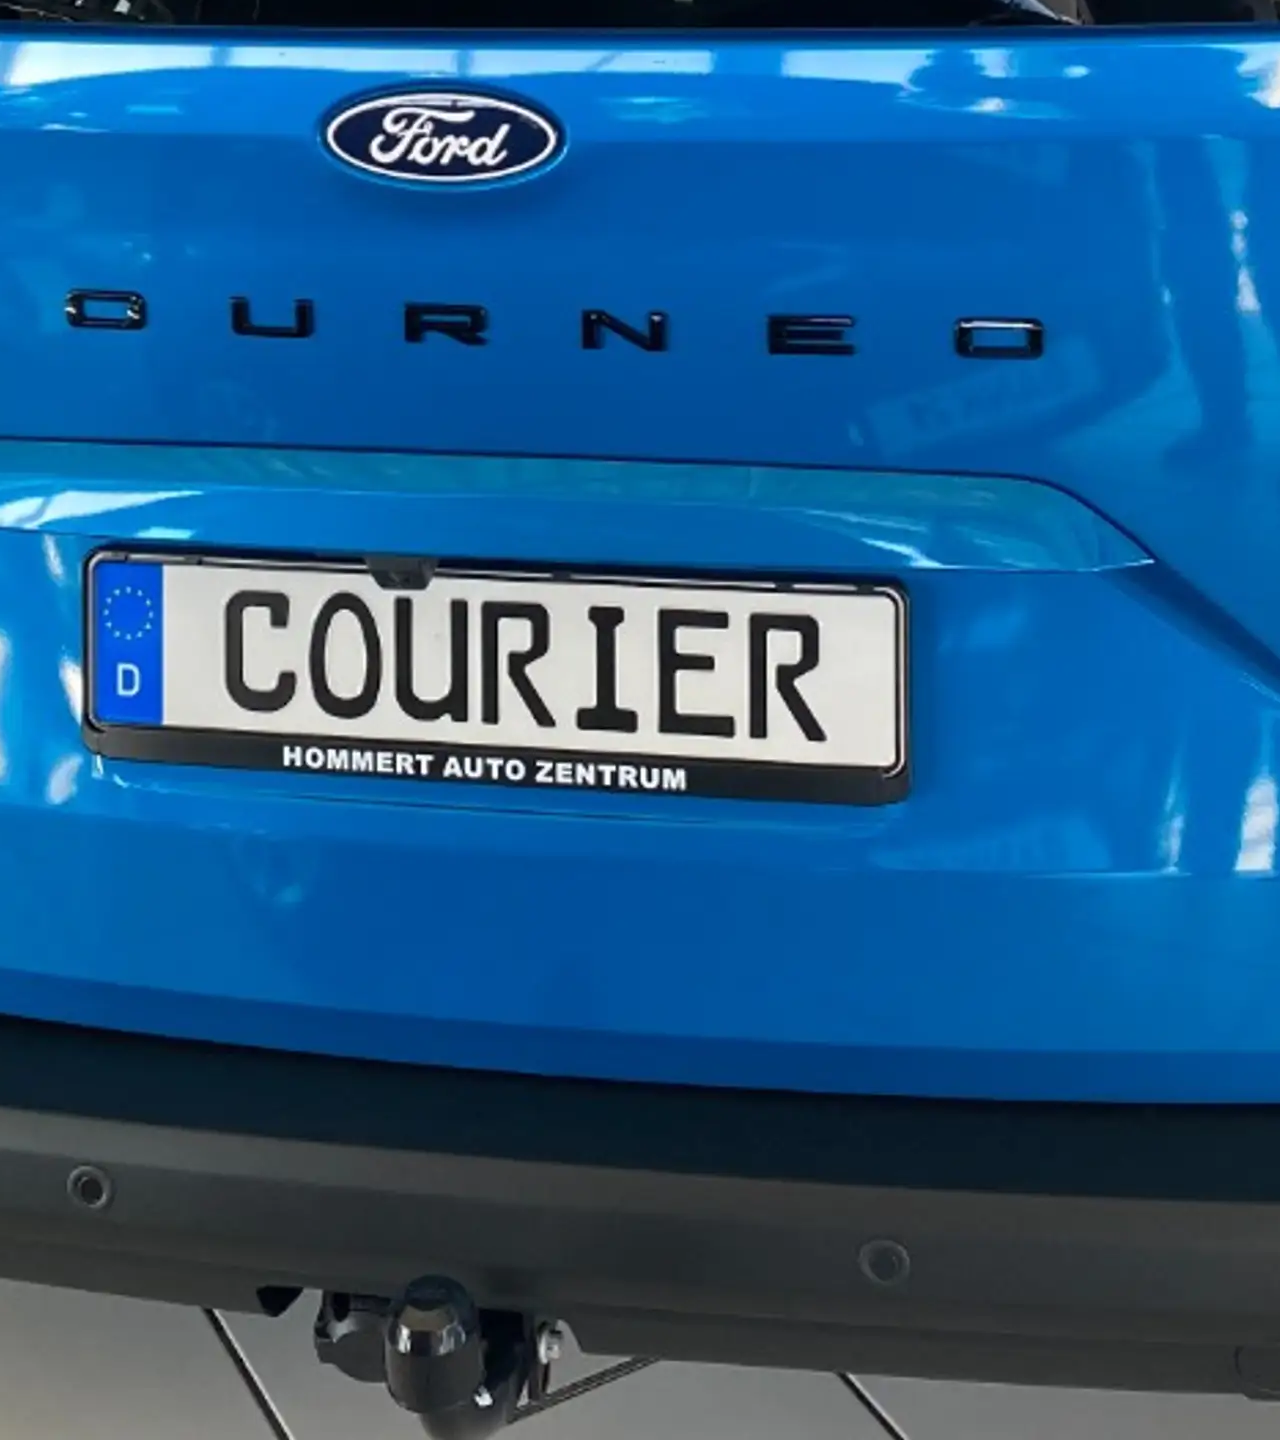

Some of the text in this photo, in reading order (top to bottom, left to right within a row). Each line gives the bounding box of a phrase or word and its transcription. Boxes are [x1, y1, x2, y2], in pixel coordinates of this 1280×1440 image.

[370, 107, 510, 166] Ford
[116, 662, 141, 697] D
[224, 589, 827, 742] COURIER
[283, 745, 687, 791] HOMMERT AUTO ZENTRUM
